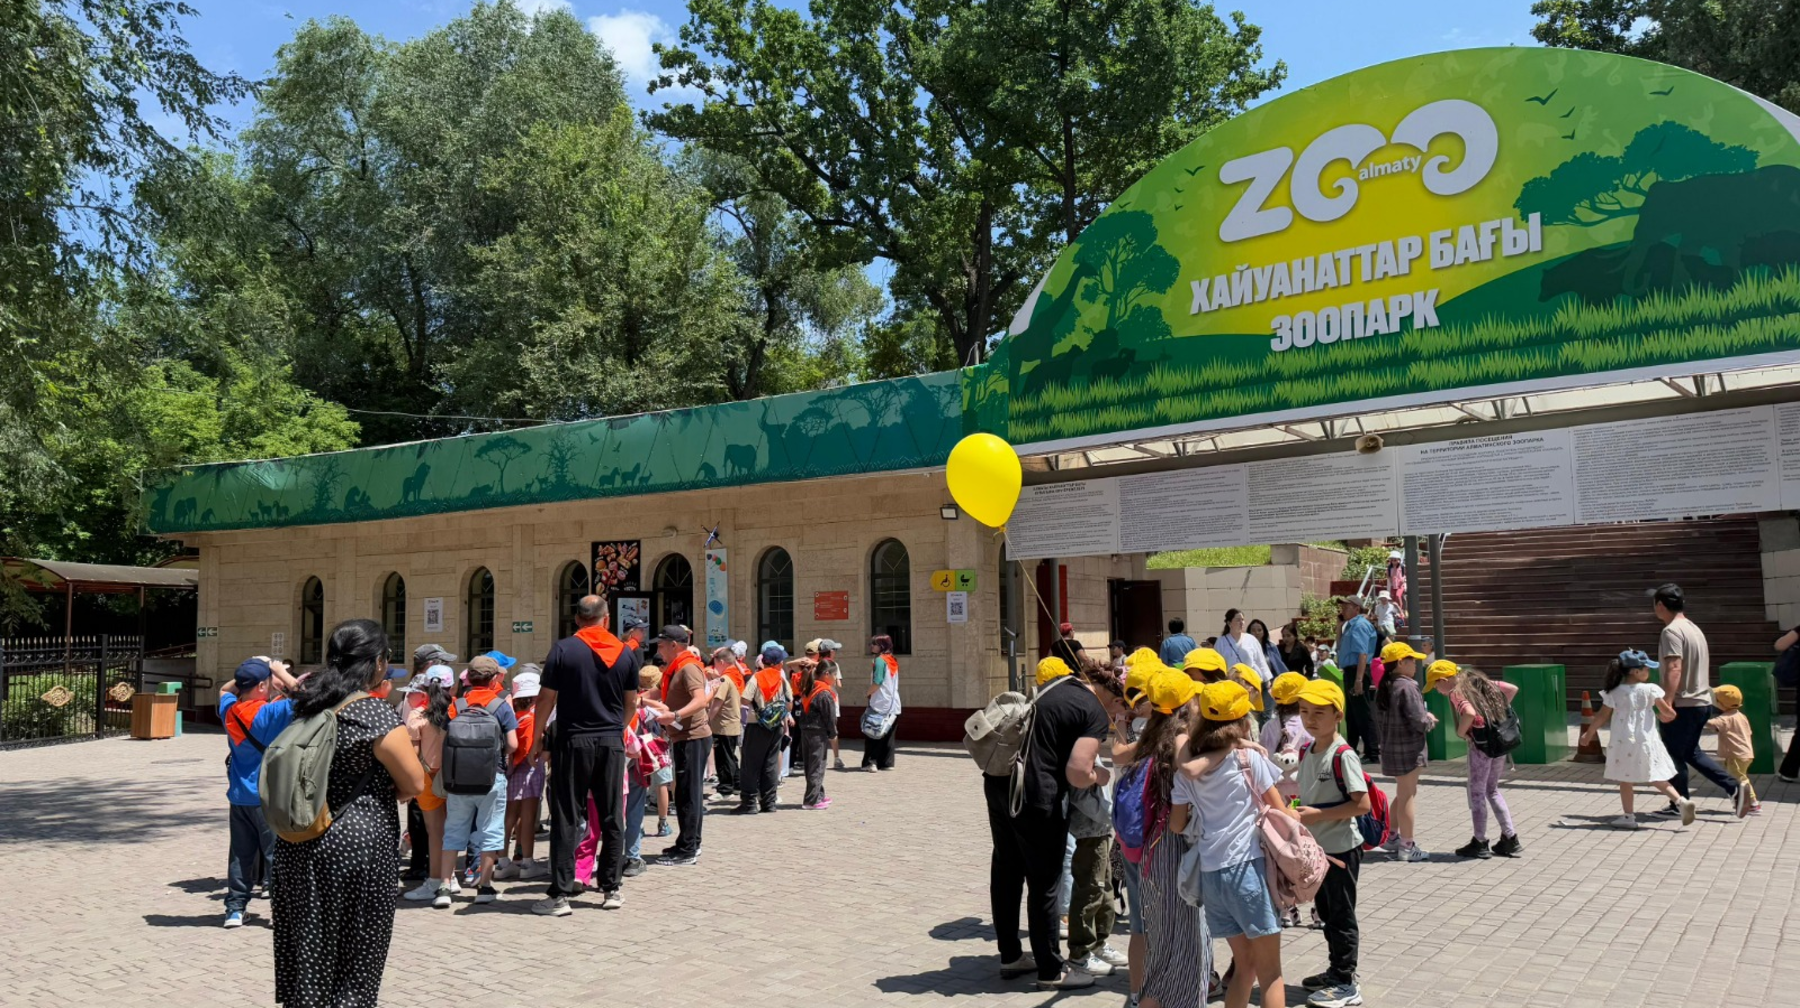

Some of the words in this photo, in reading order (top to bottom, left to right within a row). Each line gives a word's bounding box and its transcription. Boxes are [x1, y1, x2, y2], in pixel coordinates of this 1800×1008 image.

[1218, 99, 1499, 242] ZOO
[1358, 153, 1422, 181] almaty
[1189, 235, 1423, 315] ХАЙУАНАТТАР
[1429, 212, 1543, 270] БАҒЫ
[1270, 288, 1440, 352] ЗООПАРК
[1430, 445, 1465, 454] ТЕРРИТОРИИ
[1513, 437, 1544, 446] ЗООПАРКА
[1449, 436, 1475, 446] ПРАВИЛА
[1476, 435, 1513, 443] ПОСЕЩЕНИЯ
